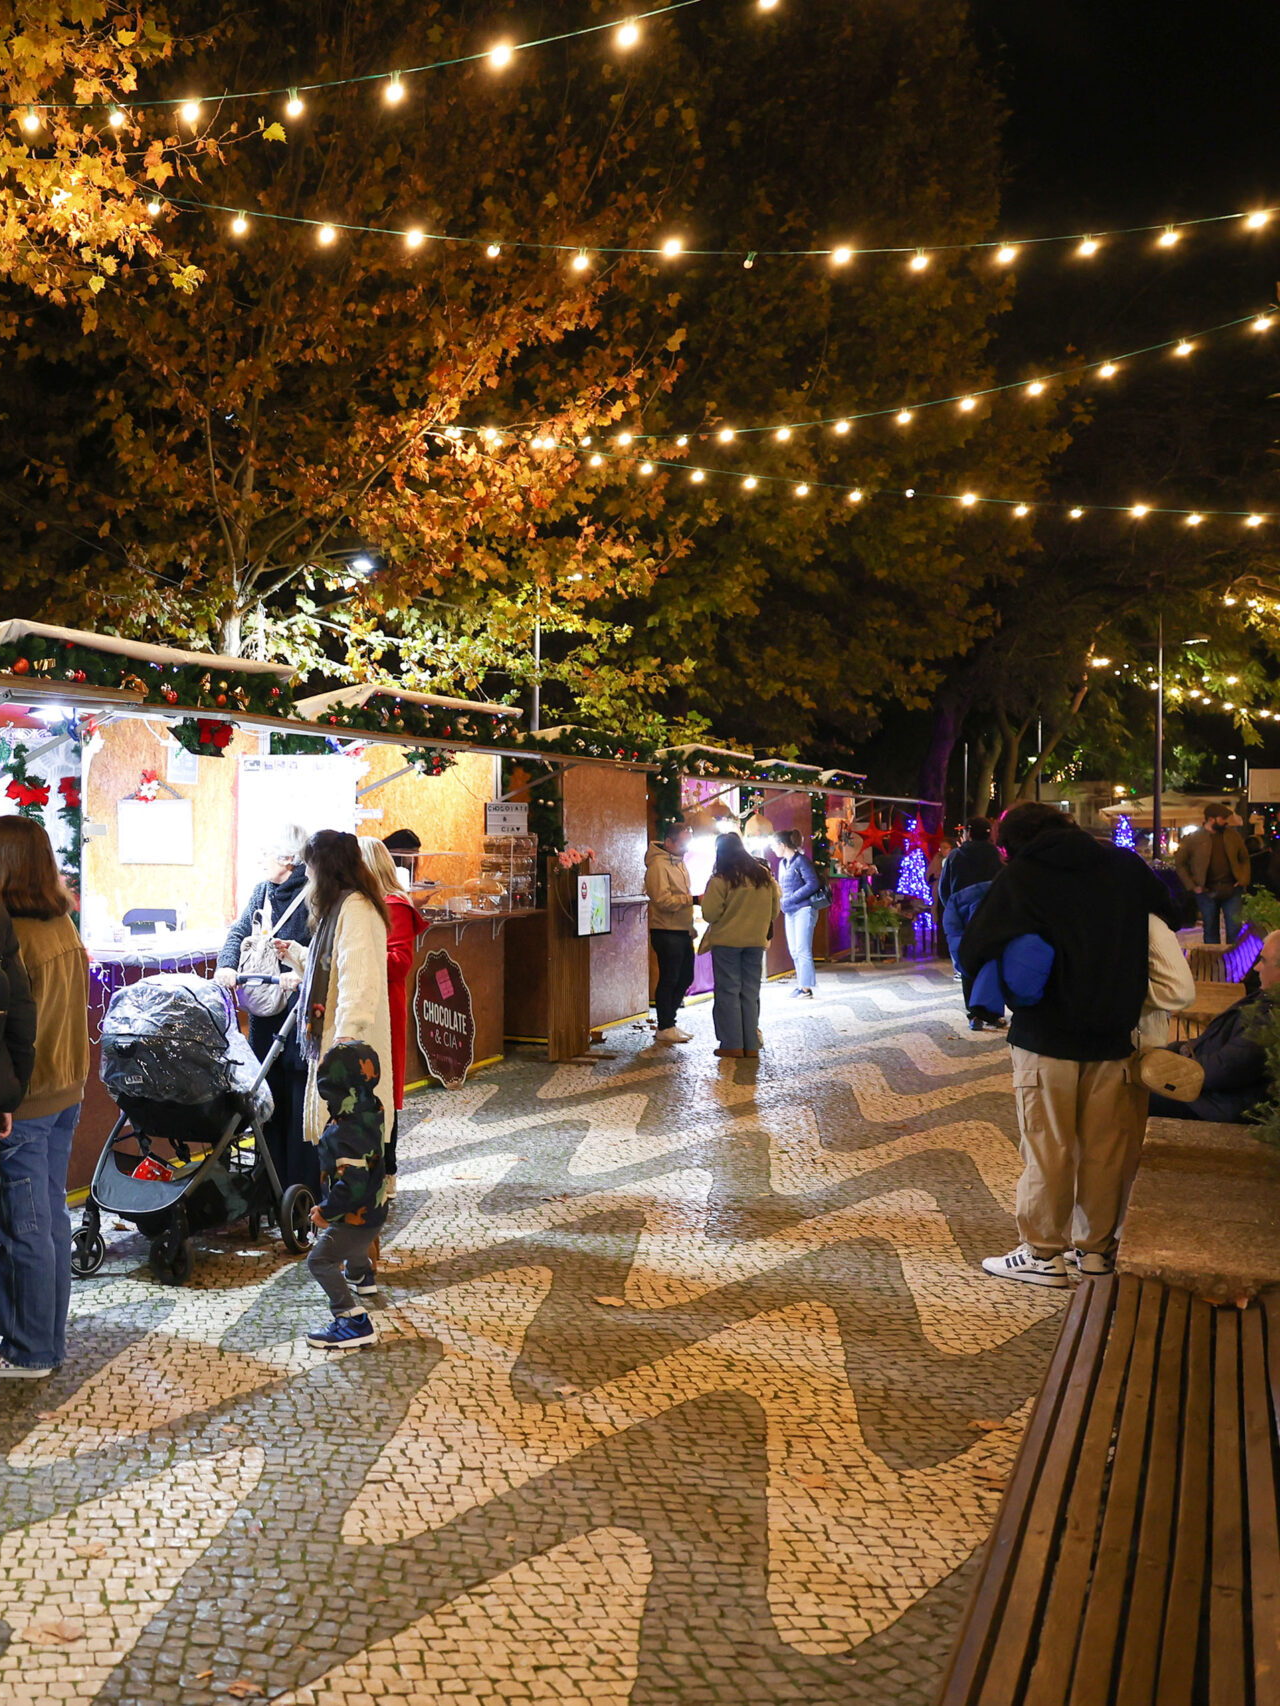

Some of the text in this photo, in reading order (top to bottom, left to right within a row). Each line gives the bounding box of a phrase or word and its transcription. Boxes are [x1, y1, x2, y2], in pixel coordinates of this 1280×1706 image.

[423, 999, 468, 1035] CHOCOLATE
[434, 1029, 458, 1050] & CIA
